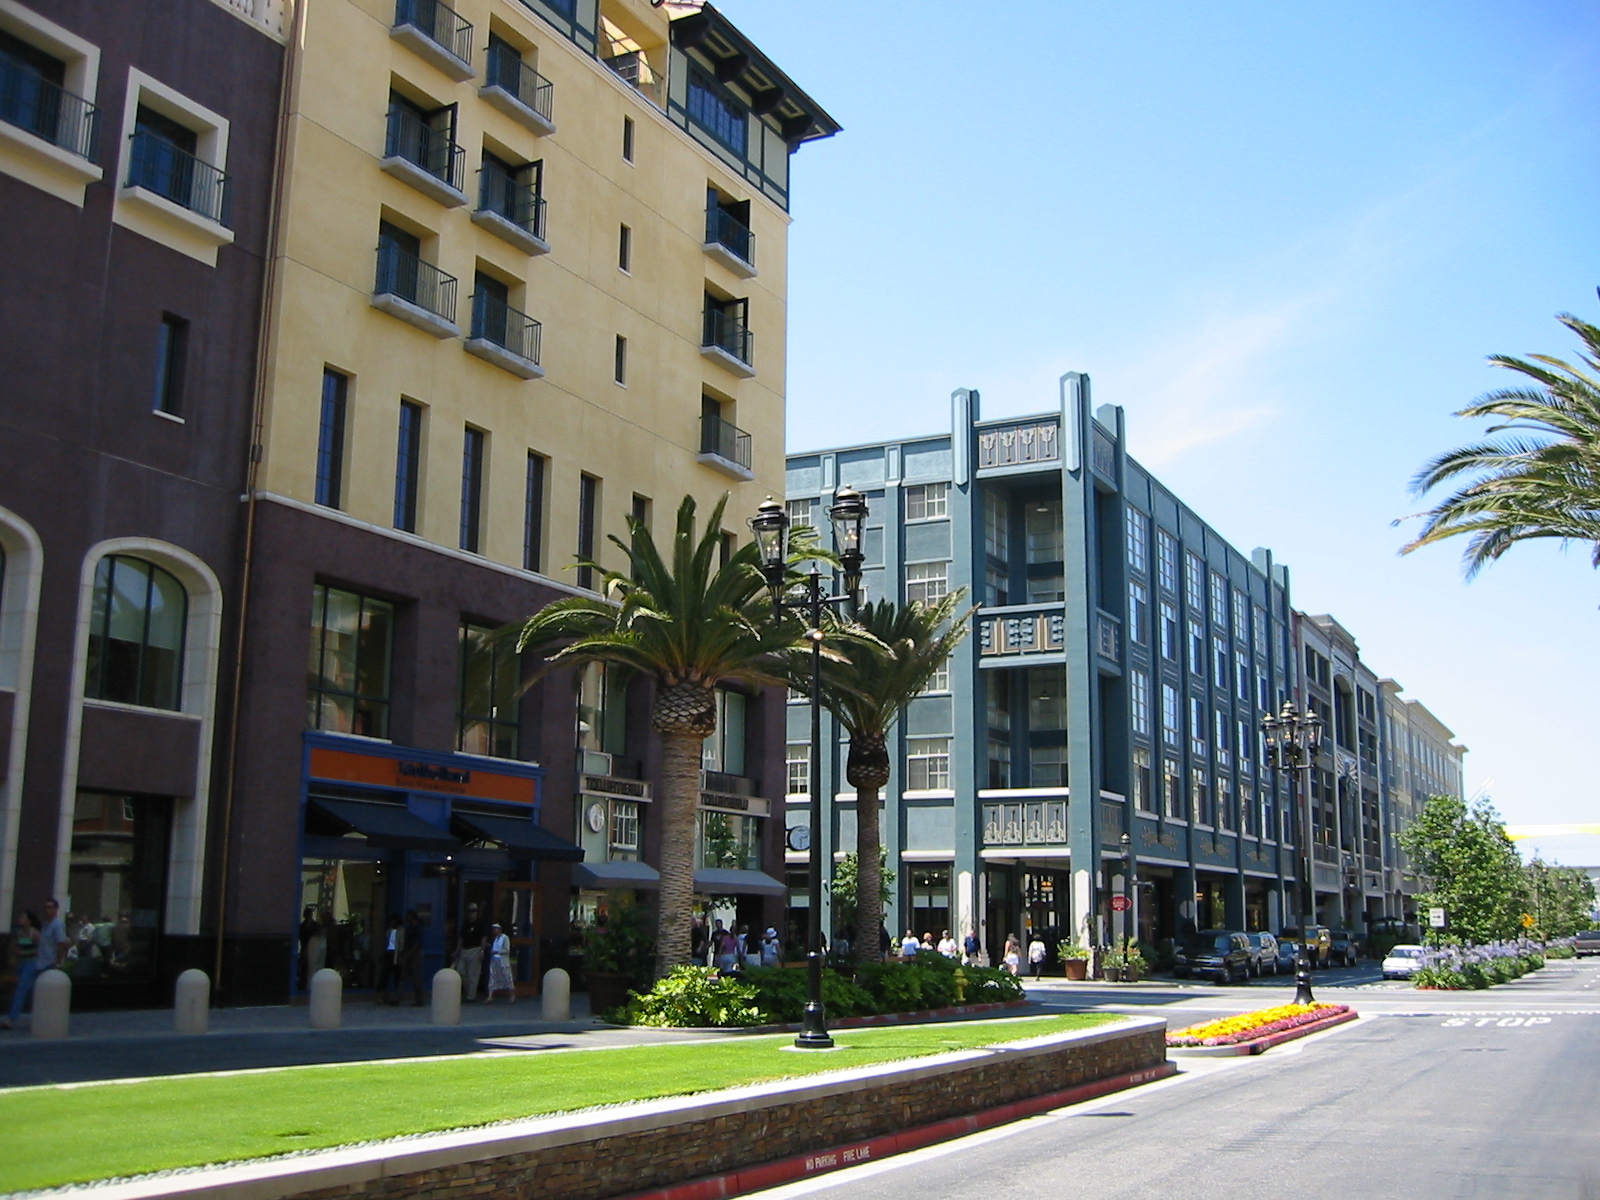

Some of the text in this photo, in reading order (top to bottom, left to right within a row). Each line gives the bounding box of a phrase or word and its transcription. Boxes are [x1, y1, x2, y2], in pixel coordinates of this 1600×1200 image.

[1440, 1017, 1552, 1027] STOP
[805, 1146, 871, 1170] NO PARKING FIRE LANE
